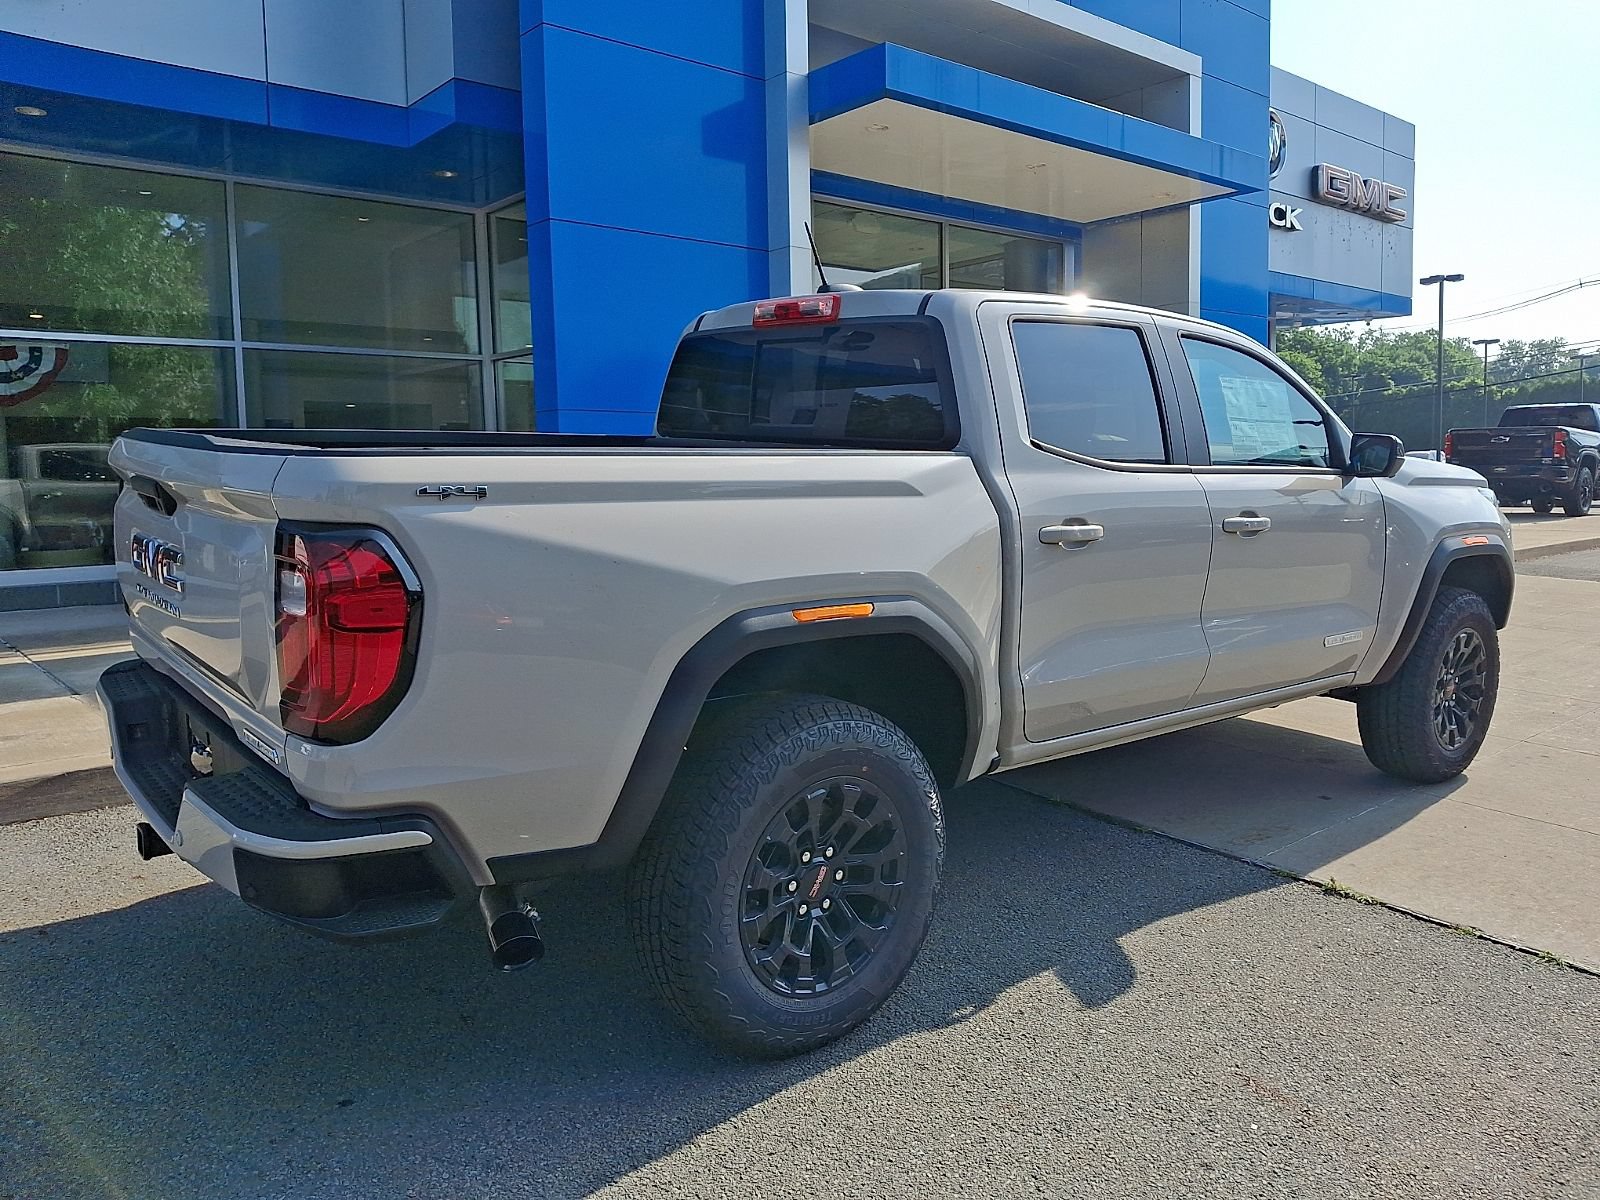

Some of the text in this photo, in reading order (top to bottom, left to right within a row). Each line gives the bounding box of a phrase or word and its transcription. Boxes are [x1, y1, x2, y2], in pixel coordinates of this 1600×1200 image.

[1316, 163, 1407, 222] GMC
[132, 531, 184, 592] GMC
[809, 866, 827, 898] GMC
